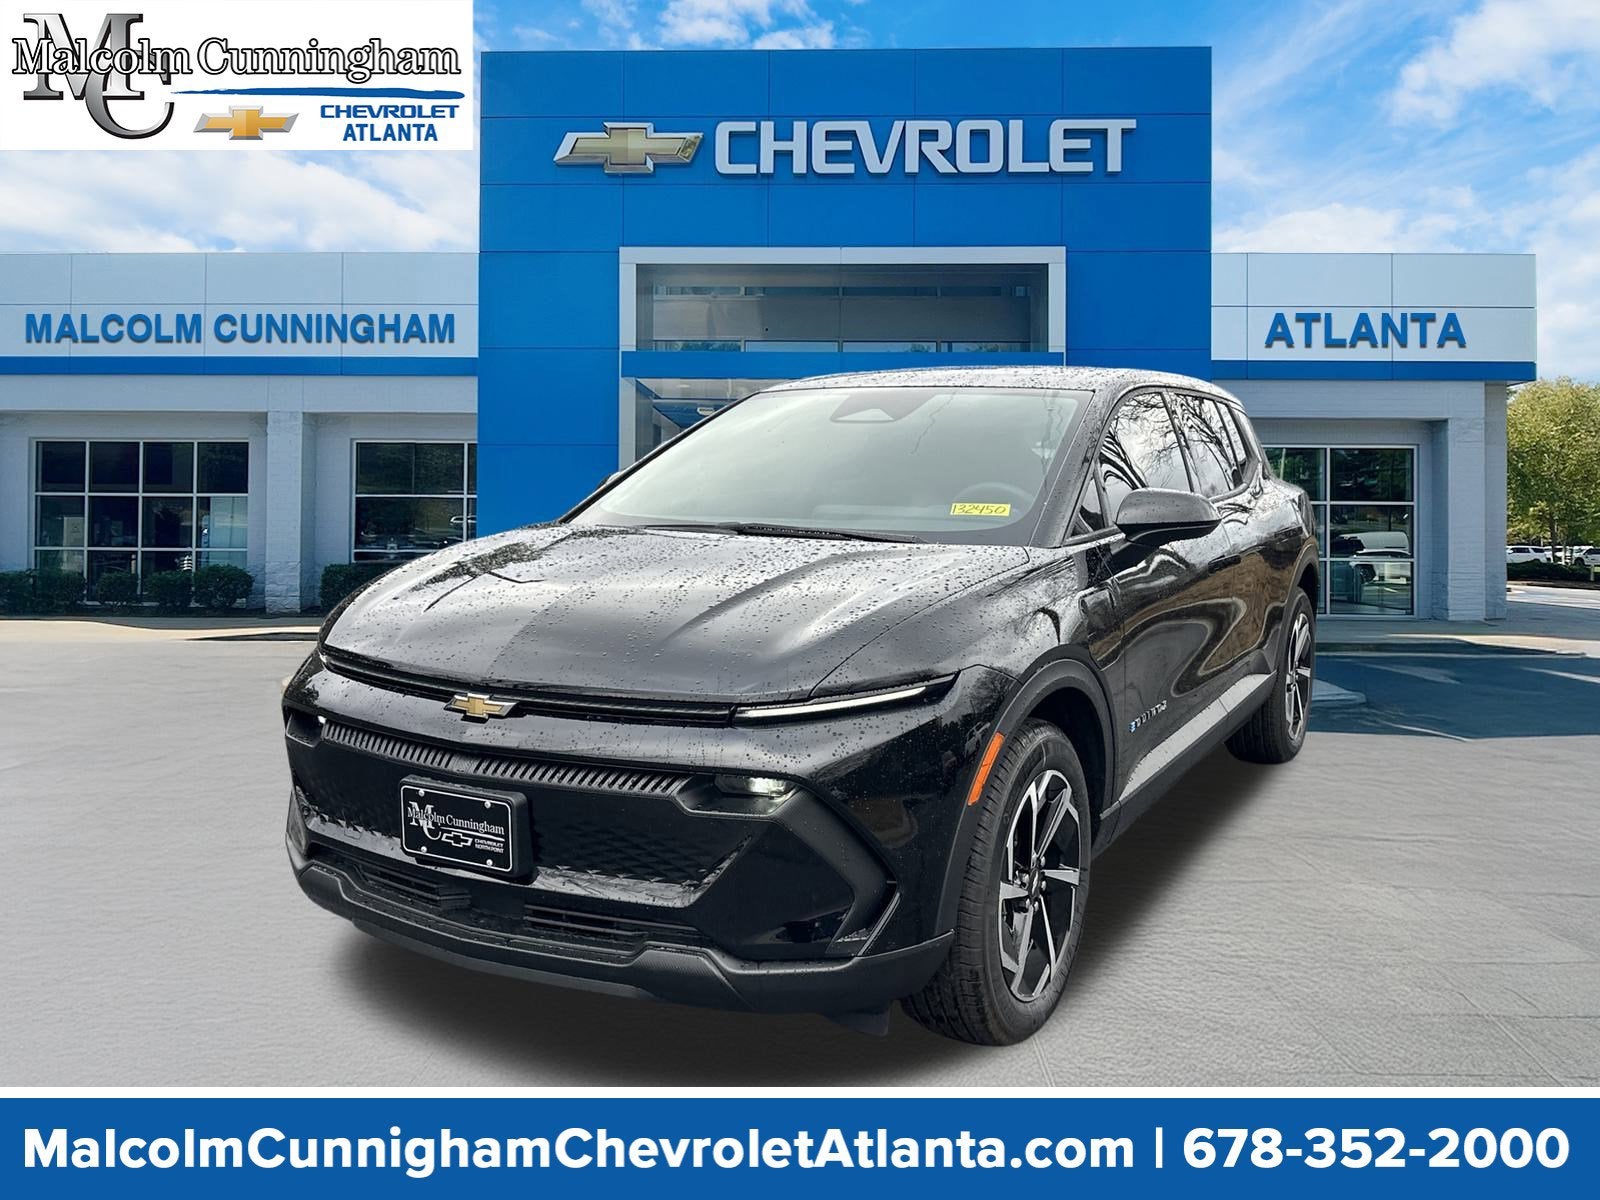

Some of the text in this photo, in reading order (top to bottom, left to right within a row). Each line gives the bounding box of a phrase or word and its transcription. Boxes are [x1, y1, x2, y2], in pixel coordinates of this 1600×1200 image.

[715, 119, 1137, 175] CHEVROLET
[25, 313, 456, 343] MALCOLM CUNNINGHAM
[1265, 312, 1467, 348] ATLANTA
[951, 504, 1007, 515] 132450
[407, 807, 505, 835] Malcolm Cunningham
